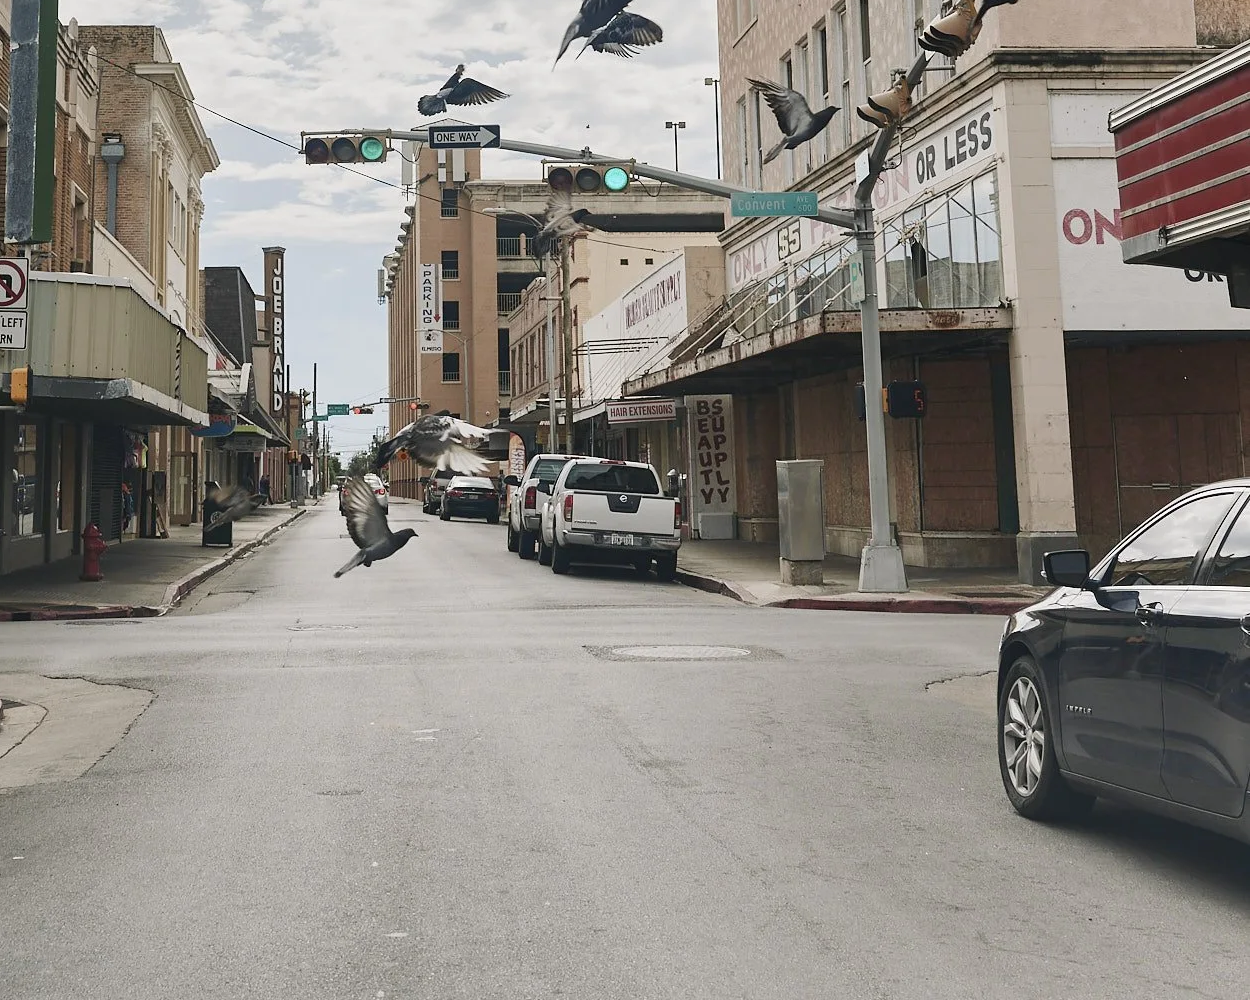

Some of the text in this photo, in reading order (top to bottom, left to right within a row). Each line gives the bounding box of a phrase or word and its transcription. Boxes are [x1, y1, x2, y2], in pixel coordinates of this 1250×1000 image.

[436, 132, 478, 142] ONE WAY
[734, 236, 769, 283] ONLY
[916, 144, 936, 184] OR
[943, 111, 992, 171] LESS
[796, 195, 808, 203] AVE
[737, 199, 786, 211] Convent
[422, 270, 433, 324] PARKING
[1, 317, 24, 328] LEFT
[272, 258, 284, 412] JOE BRAND
[610, 404, 673, 417] HAIR EXTENSIONS
[696, 399, 730, 504] BEAUTY SUPPLY
